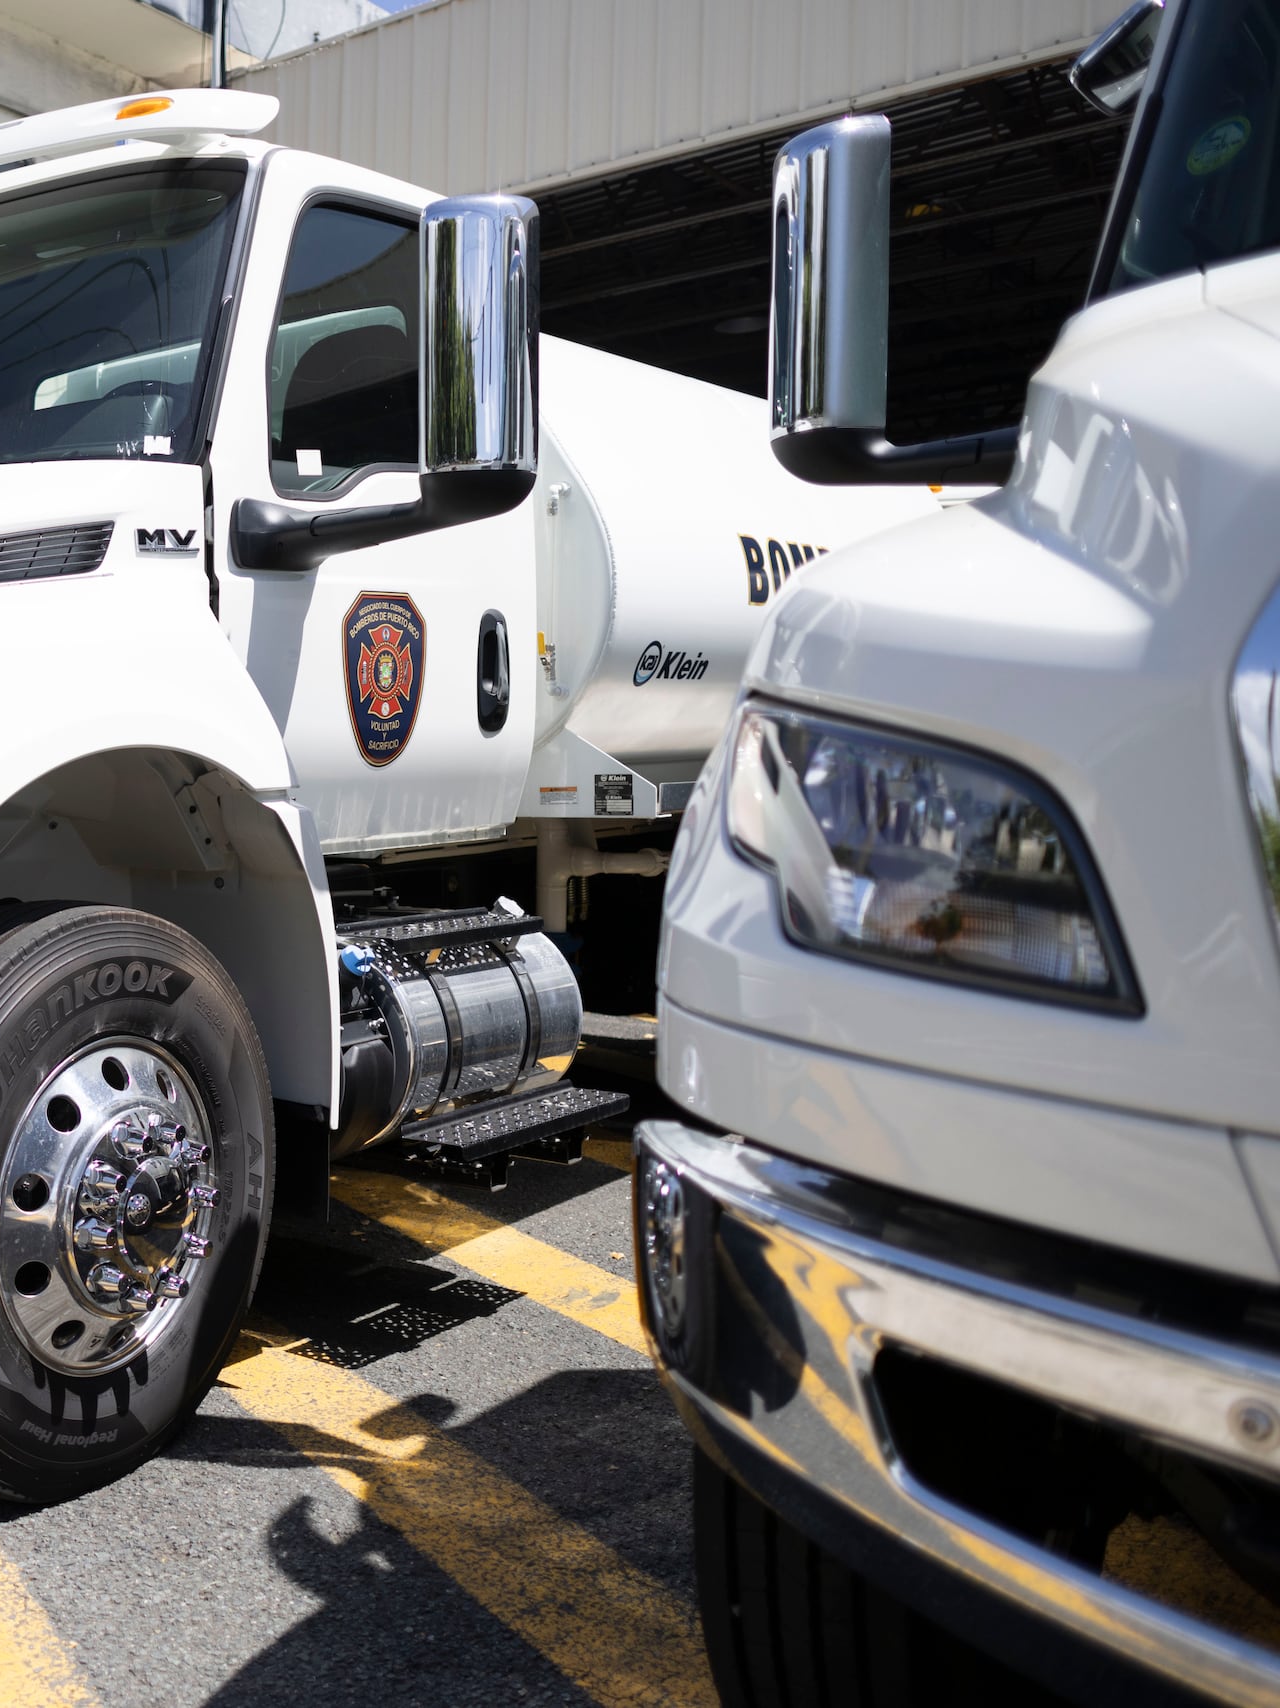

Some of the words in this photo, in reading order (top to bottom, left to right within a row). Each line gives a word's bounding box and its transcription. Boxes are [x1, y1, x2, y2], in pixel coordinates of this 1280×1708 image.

[135, 528, 197, 548] MV
[737, 533, 830, 606] BO
[349, 612, 379, 639] BOMBEROS
[379, 612, 388, 621] DE
[387, 612, 408, 628] PUERTO
[407, 622, 420, 640] RICO
[655, 651, 709, 680] Klein
[370, 720, 400, 731] VOLUNTAD
[368, 739, 400, 750] SACRIFICIO
[382, 732, 388, 741] Y
[20, 1419, 53, 1443] Haul
[52, 1428, 119, 1449] Regional
